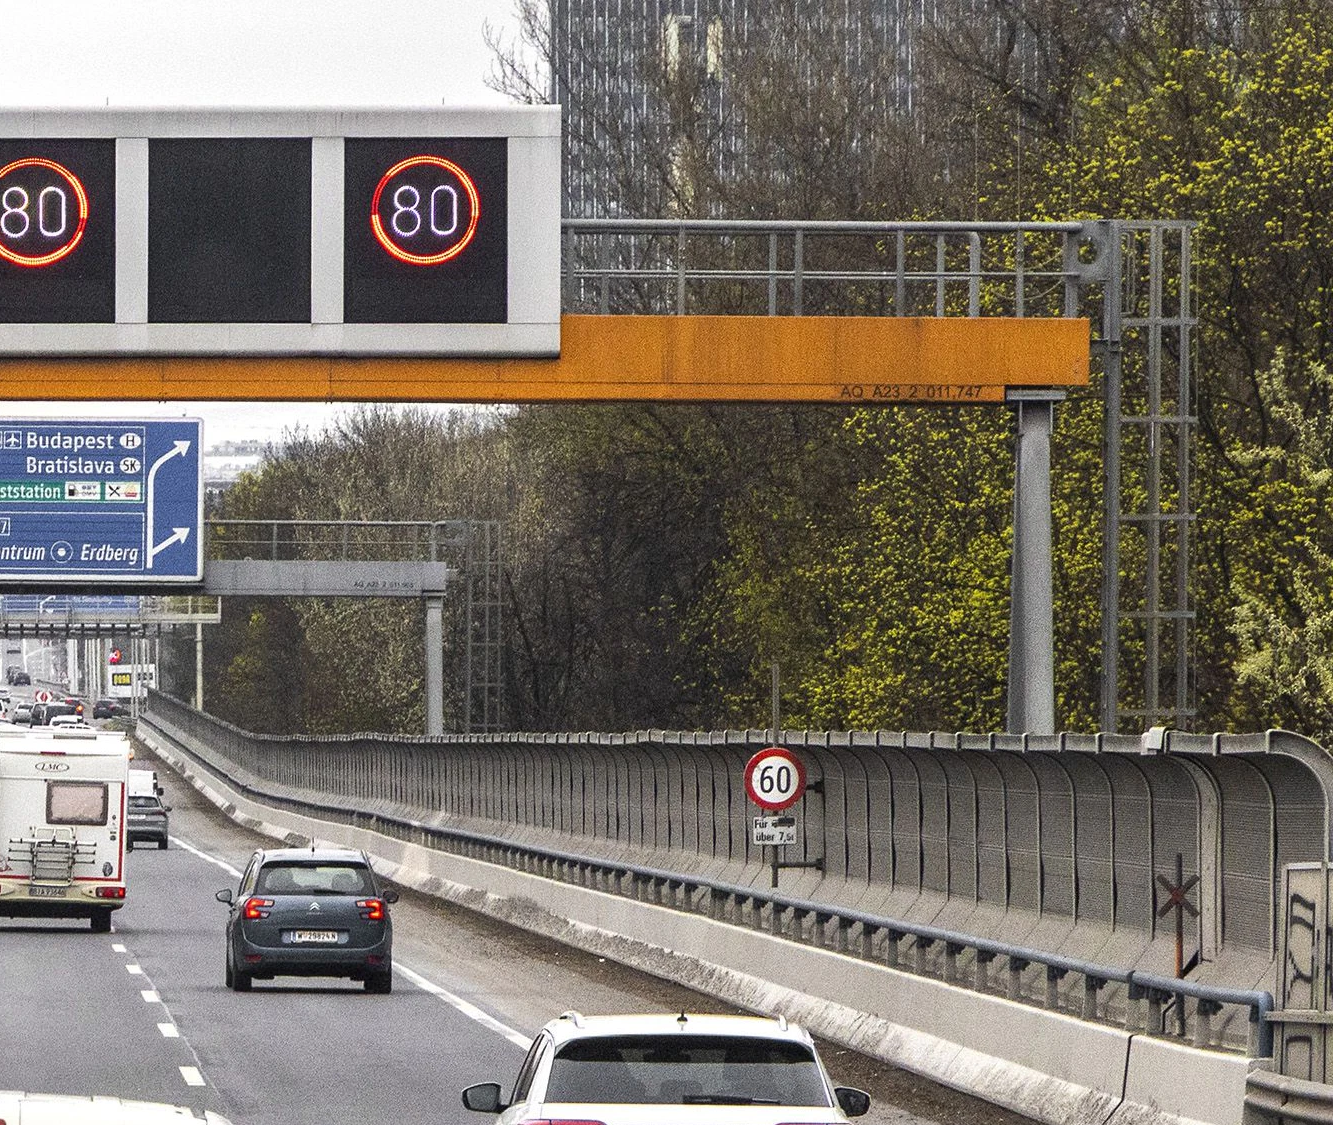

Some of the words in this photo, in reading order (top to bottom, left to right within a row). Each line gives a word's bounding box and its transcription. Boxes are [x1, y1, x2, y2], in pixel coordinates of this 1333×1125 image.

[0, 186, 66, 238] 80
[393, 185, 457, 237] 80
[872, 384, 900, 399] A23
[908, 385, 918, 399] 2
[26, 432, 114, 452] Budapest
[26, 456, 115, 474] Bratislava
[123, 459, 137, 472] SK
[80, 543, 138, 565] Erdberg
[760, 765, 791, 794] 60
[754, 819, 768, 829] Für
[756, 831, 775, 842] über
